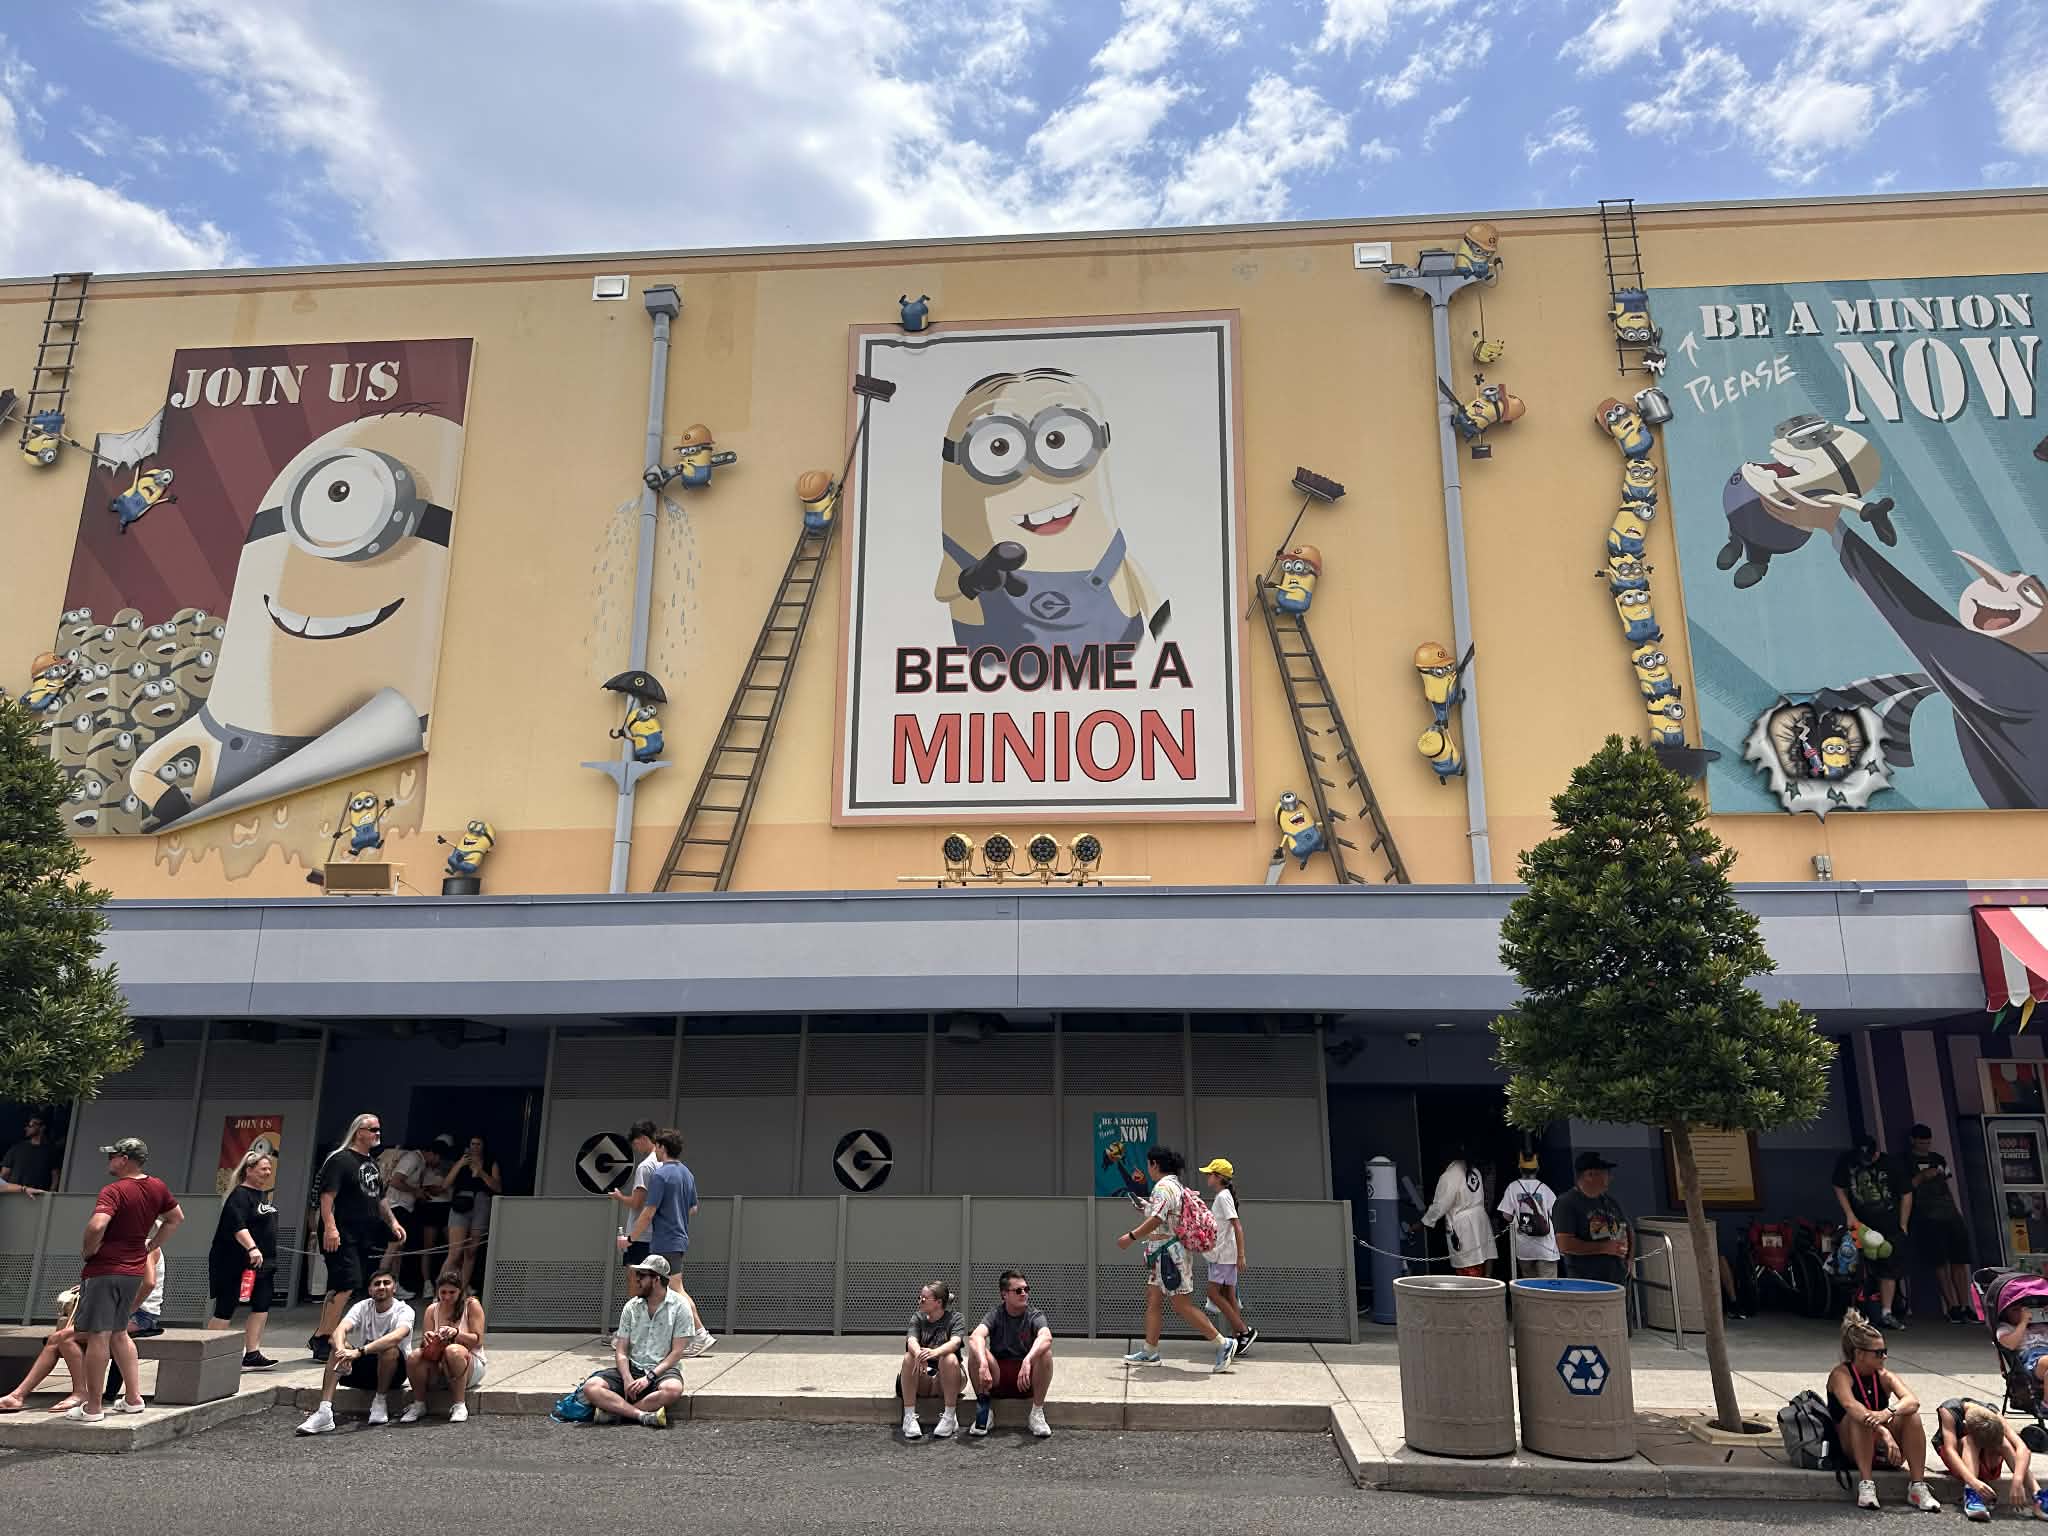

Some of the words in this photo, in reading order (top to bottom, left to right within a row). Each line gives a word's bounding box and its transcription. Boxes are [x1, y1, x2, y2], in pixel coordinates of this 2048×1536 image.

[1700, 303, 1771, 338] BE
[1785, 302, 1822, 335] A
[1832, 293, 2033, 333] MINION
[171, 364, 309, 409] JOIN
[328, 361, 400, 403] US
[1684, 355, 1799, 414] PLEASE
[1834, 335, 2039, 423] NOW
[895, 643, 1138, 694] BECOME
[1149, 641, 1194, 689] A
[892, 709, 1197, 784] MINION
[234, 1119, 257, 1129] JOIN
[259, 1119, 273, 1129] US
[1120, 1126, 1149, 1143] NOW
